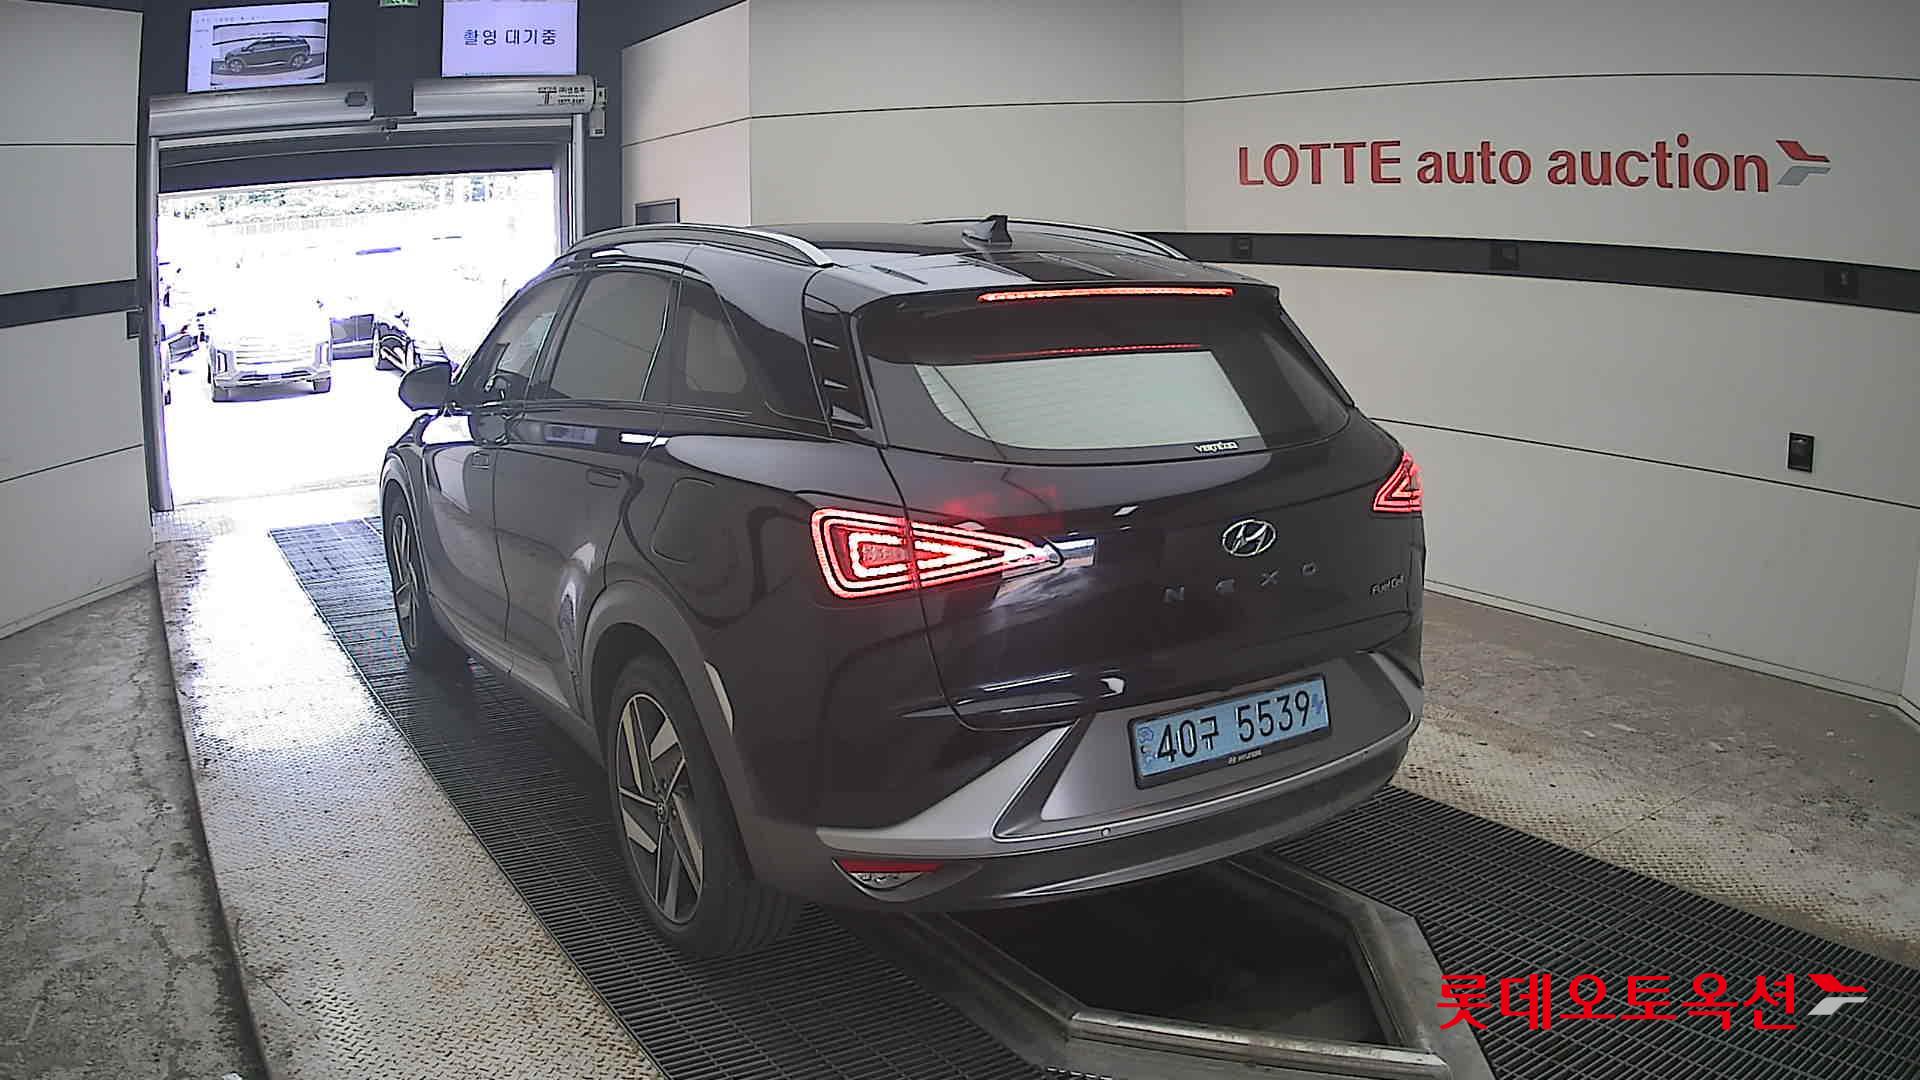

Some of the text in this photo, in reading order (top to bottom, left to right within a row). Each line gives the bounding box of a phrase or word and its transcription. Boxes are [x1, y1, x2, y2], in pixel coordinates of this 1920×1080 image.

[464, 29, 557, 46] 촬영 대기중
[1238, 133, 1769, 192] LOTTE auto auction
[1157, 690, 1310, 763] 40구 5539
